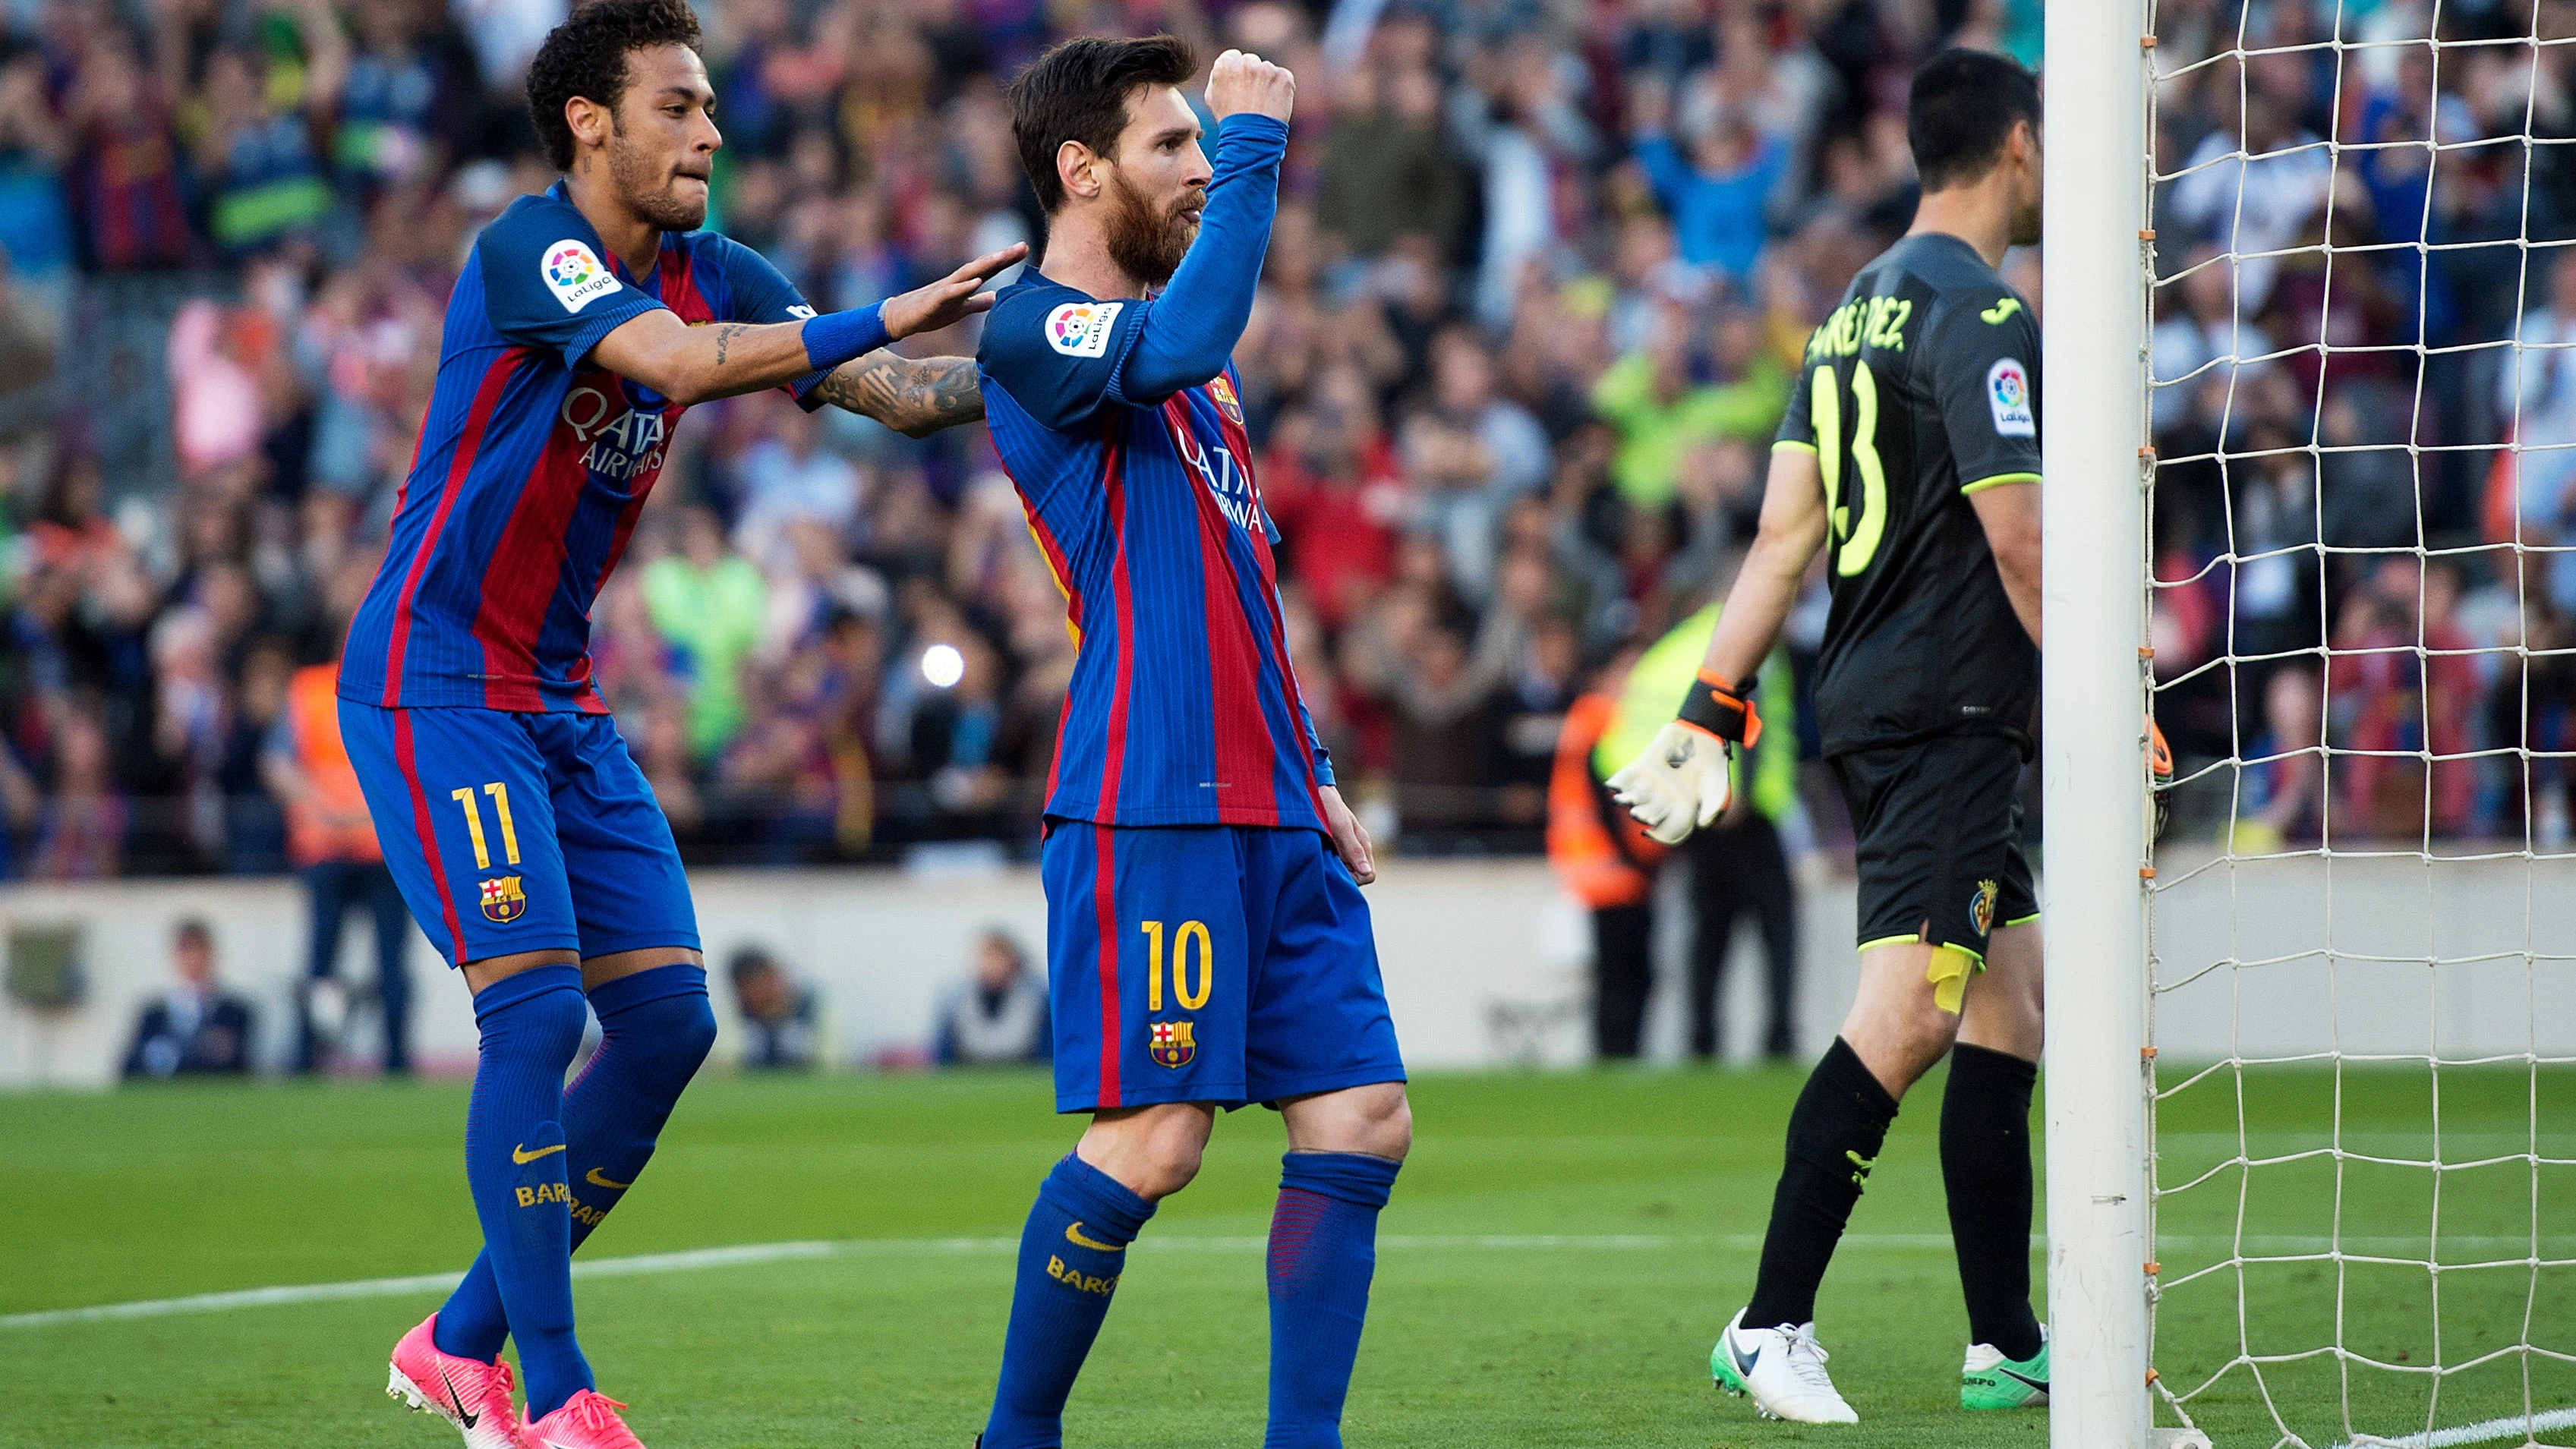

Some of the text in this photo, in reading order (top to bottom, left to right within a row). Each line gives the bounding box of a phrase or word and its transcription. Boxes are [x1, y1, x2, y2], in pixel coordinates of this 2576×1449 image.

[567, 276, 612, 302] LaLiga
[1088, 307, 1112, 350] LaLiga
[562, 387, 673, 455] QATA
[1811, 358, 1887, 577] 13
[452, 782, 521, 870] 11
[1141, 920, 1212, 1011] 10
